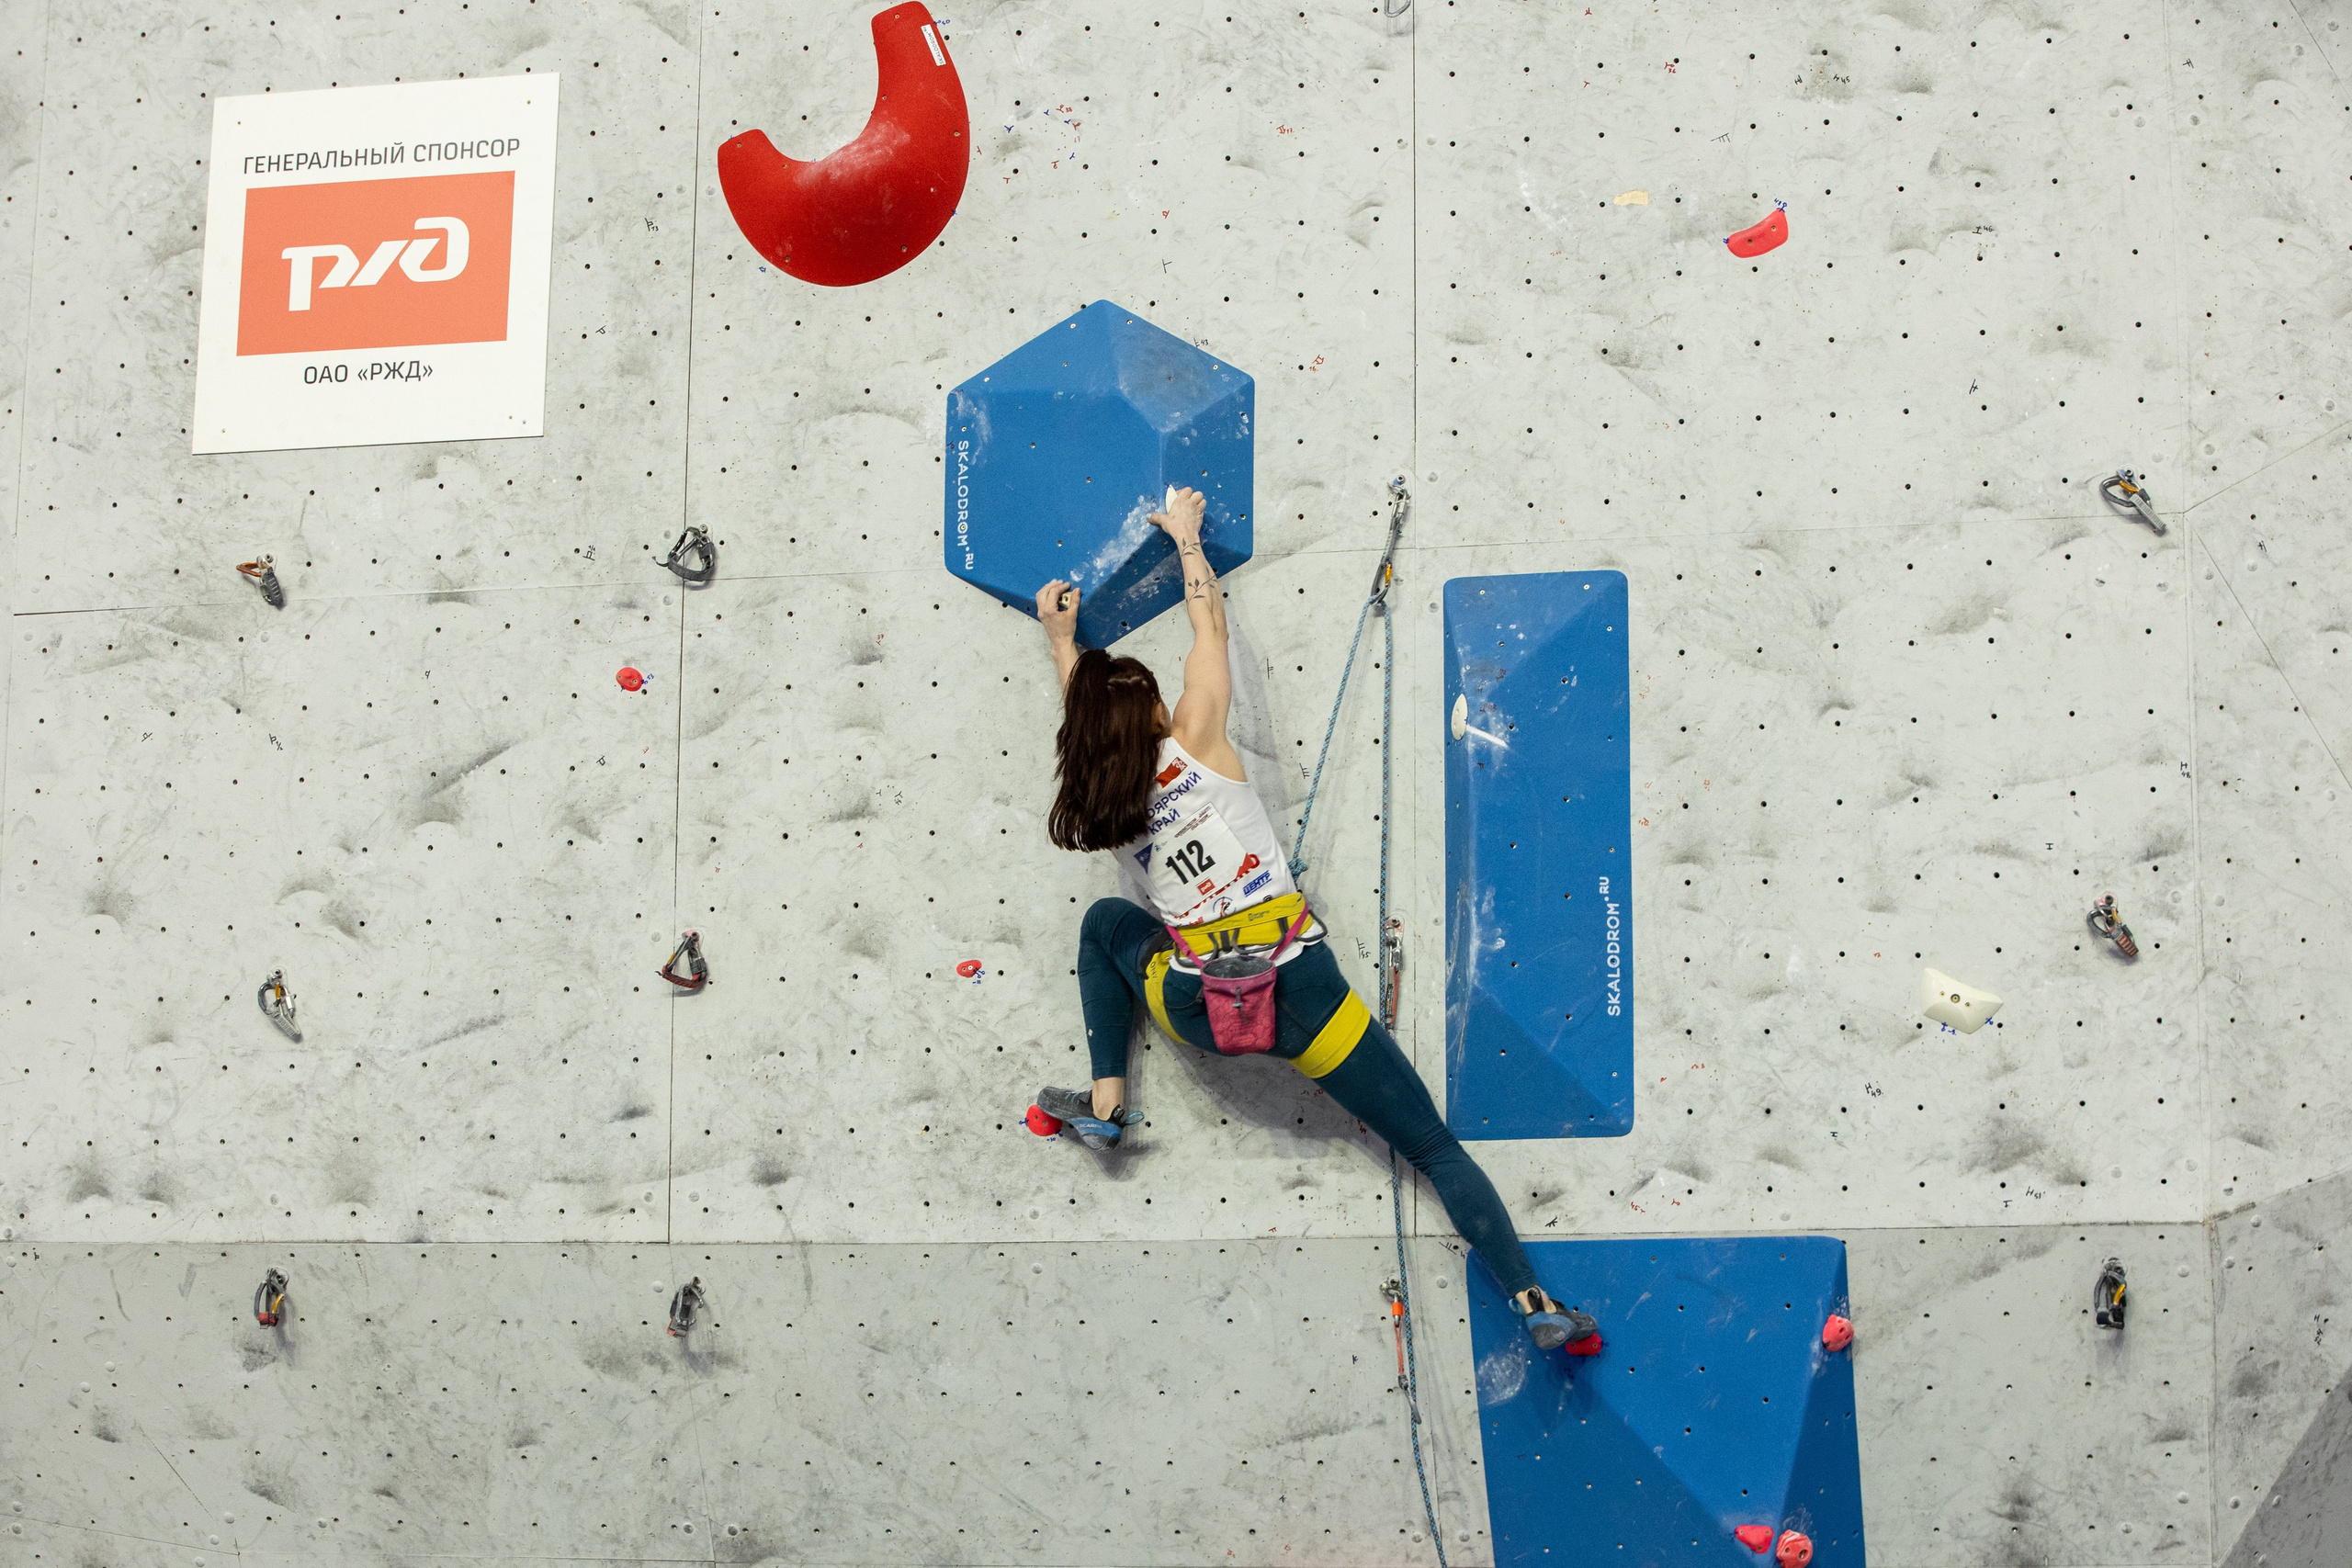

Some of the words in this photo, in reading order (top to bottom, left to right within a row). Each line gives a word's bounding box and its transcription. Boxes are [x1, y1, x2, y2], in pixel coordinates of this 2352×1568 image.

[243, 141, 405, 175] ГЕНЕРАЛЬНЫЙ
[413, 138, 521, 163] СПОНСОР
[303, 364, 349, 385] ОАО
[357, 360, 434, 382] «РЖД»
[1148, 807, 1181, 836] КРАЙ
[1165, 840, 1216, 886] 112
